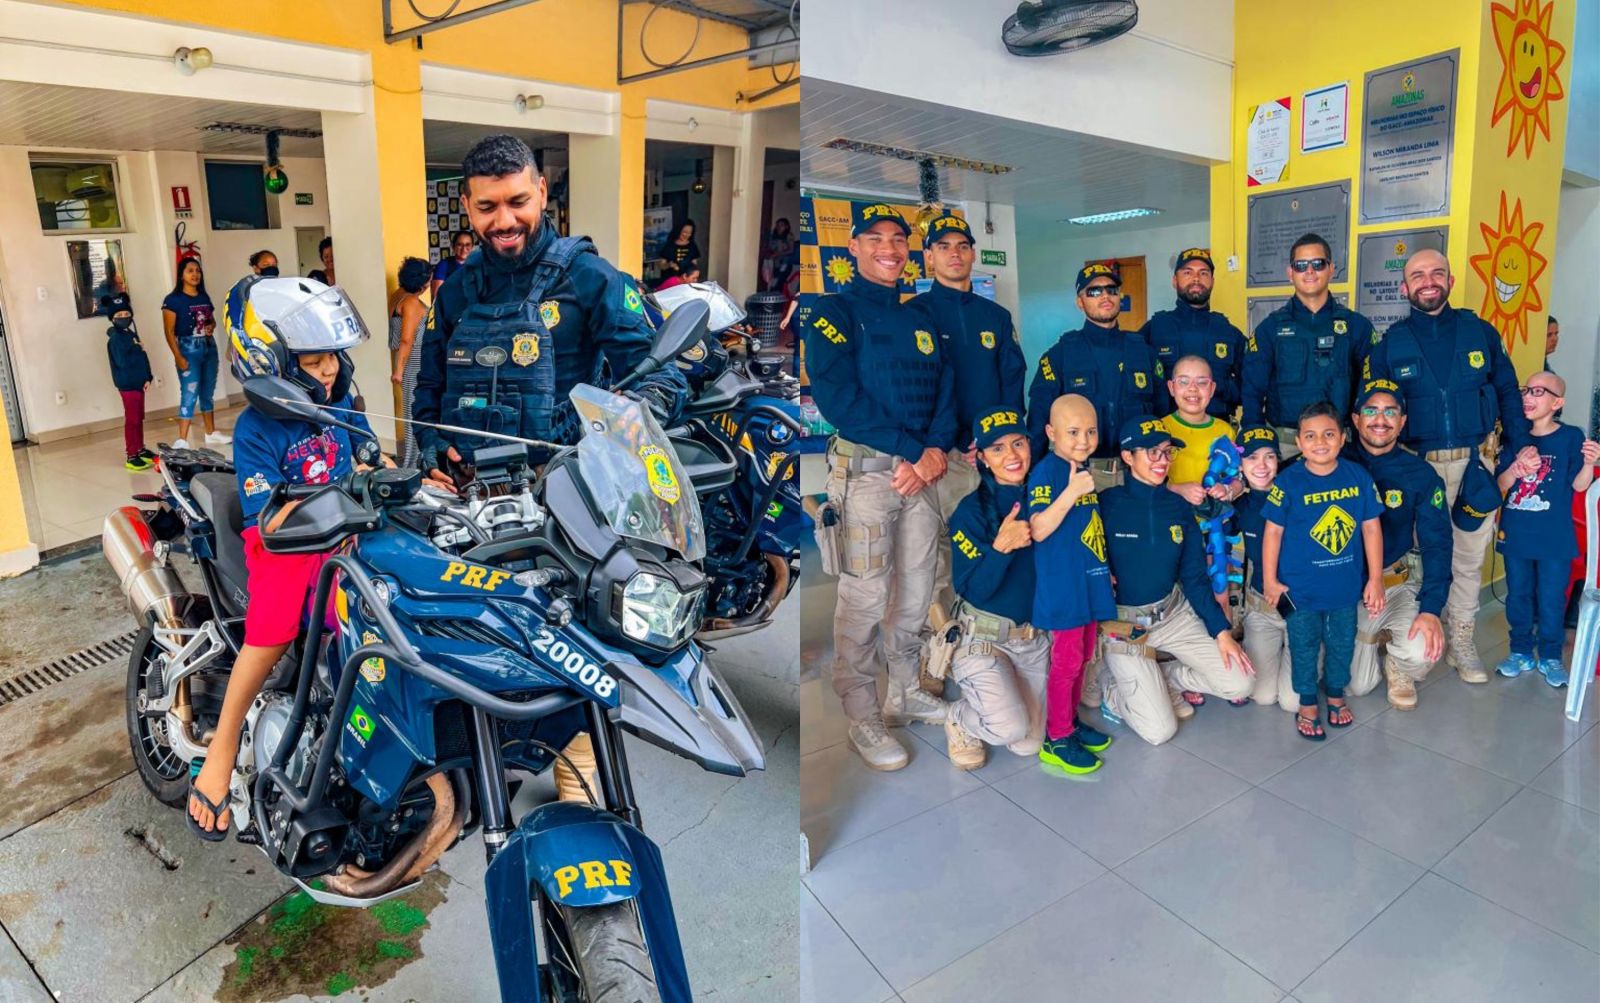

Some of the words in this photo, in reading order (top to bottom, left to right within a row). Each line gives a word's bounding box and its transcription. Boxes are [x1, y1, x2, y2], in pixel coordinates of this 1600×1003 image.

[814, 317, 847, 345] PRF
[980, 411, 1019, 433] PRF
[1243, 428, 1275, 443] PRF
[1074, 493, 1099, 507] FETR
[1303, 486, 1360, 506] FETRAN
[440, 562, 511, 591] PRF
[531, 630, 617, 698] 20008
[346, 722, 366, 749] BRASIL
[553, 860, 632, 899] PRF
